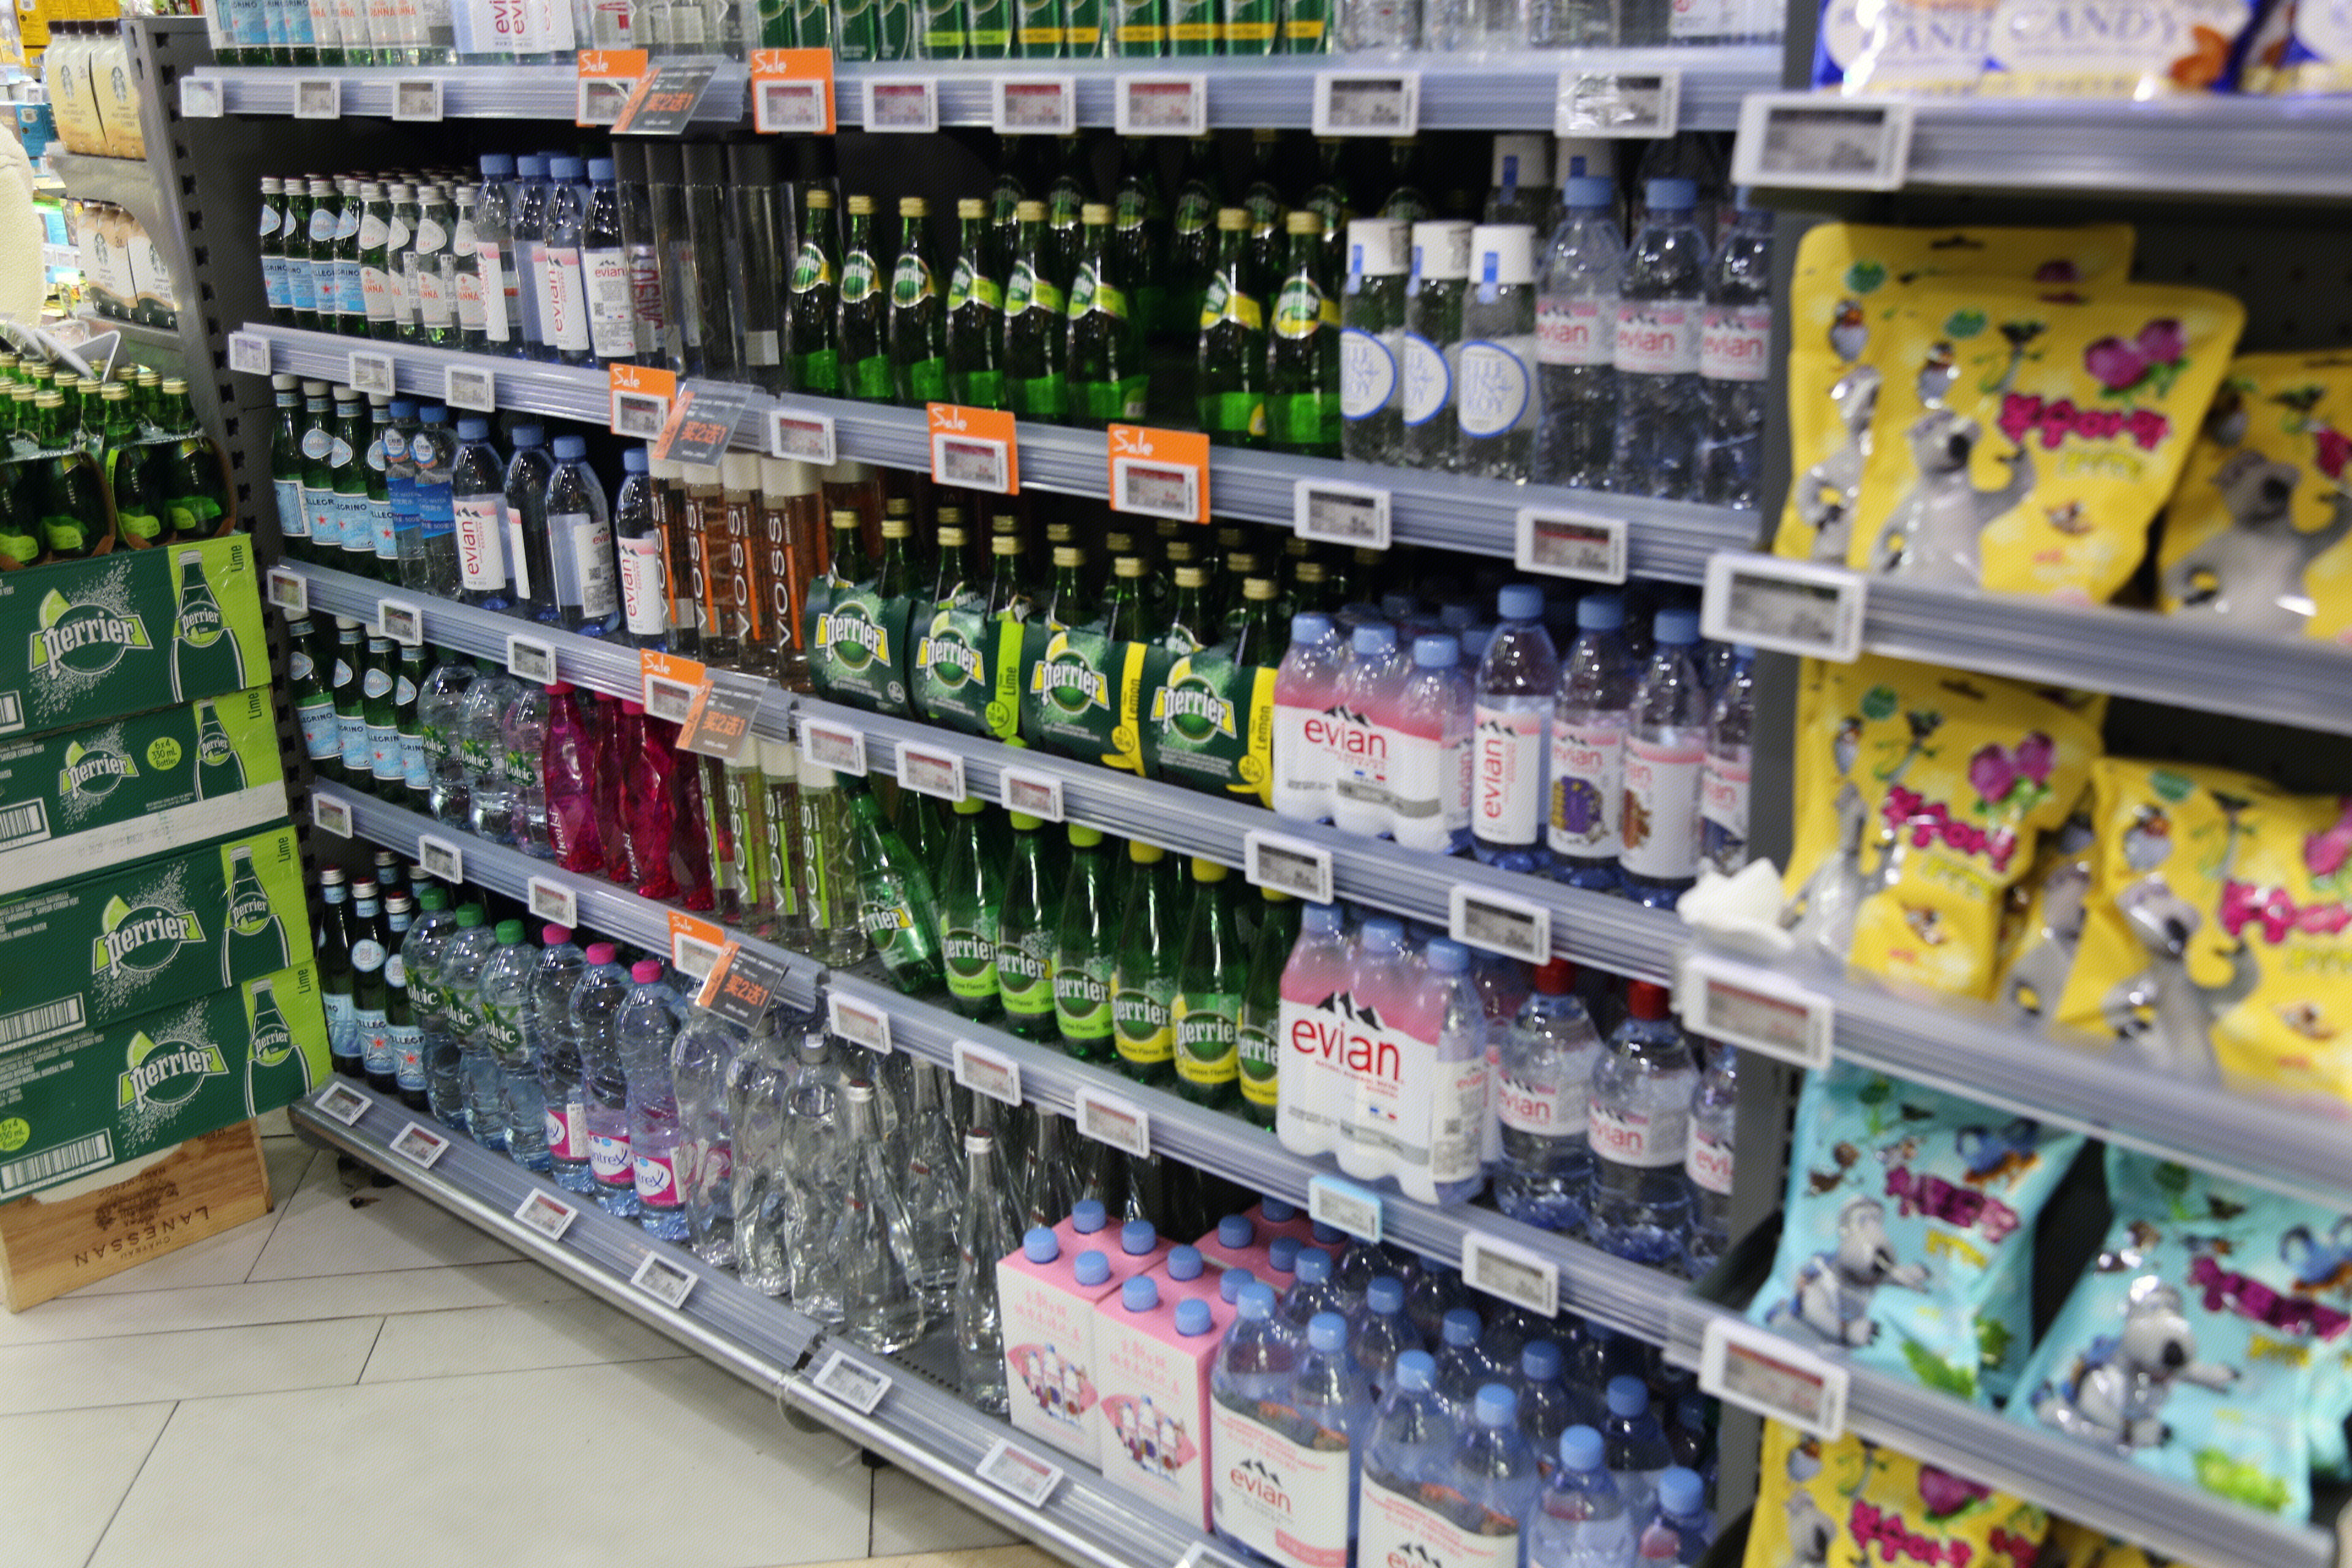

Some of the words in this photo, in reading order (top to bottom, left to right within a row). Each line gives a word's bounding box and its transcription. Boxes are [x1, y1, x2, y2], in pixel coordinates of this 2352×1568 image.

[581, 51, 609, 72] Sale
[754, 51, 787, 74] Sale
[594, 266, 625, 278] evian
[612, 368, 640, 389] Sale
[932, 407, 967, 431] Sale
[1113, 430, 1154, 457] Sale
[230, 544, 244, 573] Lime
[462, 521, 480, 576] evian
[686, 501, 707, 630] VOSS
[728, 507, 750, 638] VOSS
[769, 516, 791, 647] VOSS
[621, 558, 638, 617] evian
[182, 607, 219, 638] perrier
[826, 614, 882, 663] perrier
[42, 611, 135, 680] perrier
[925, 638, 978, 681] perrier
[644, 653, 671, 675] Sale
[1003, 666, 1017, 696] Lime
[1042, 662, 1101, 706] perrier
[247, 692, 263, 720] Lime
[1126, 679, 1140, 721] Lemon
[1164, 687, 1226, 734] perrier
[1256, 705, 1272, 750] Lemon
[1304, 718, 1388, 759] evian
[152, 748, 166, 761] 330
[166, 746, 178, 756] mL
[156, 756, 177, 768] Bottles
[200, 734, 229, 758] perrier
[461, 747, 489, 768] Volvic
[67, 753, 129, 799] perrier
[505, 761, 533, 782] Volvic
[1483, 739, 1503, 819] evian
[279, 836, 292, 864] Lime
[728, 783, 748, 899] VOSS
[765, 792, 785, 910] VOSS
[801, 804, 820, 922] VOSS
[233, 897, 268, 930] perrier
[673, 916, 693, 932] Sale
[105, 911, 191, 979] perrier
[298, 968, 312, 995] Lime
[408, 983, 438, 1006] olvic
[723, 974, 769, 1007] 买2送1
[446, 1003, 474, 1027] olvic
[486, 1019, 516, 1044] olvic
[254, 1030, 288, 1060] perrier
[1291, 1019, 1400, 1082] evian
[129, 1044, 214, 1114] perrier
[74, 1205, 209, 1268] LANESSAN
[120, 1235, 171, 1261] CHÂTEAU
[1229, 1468, 1292, 1513] evian
